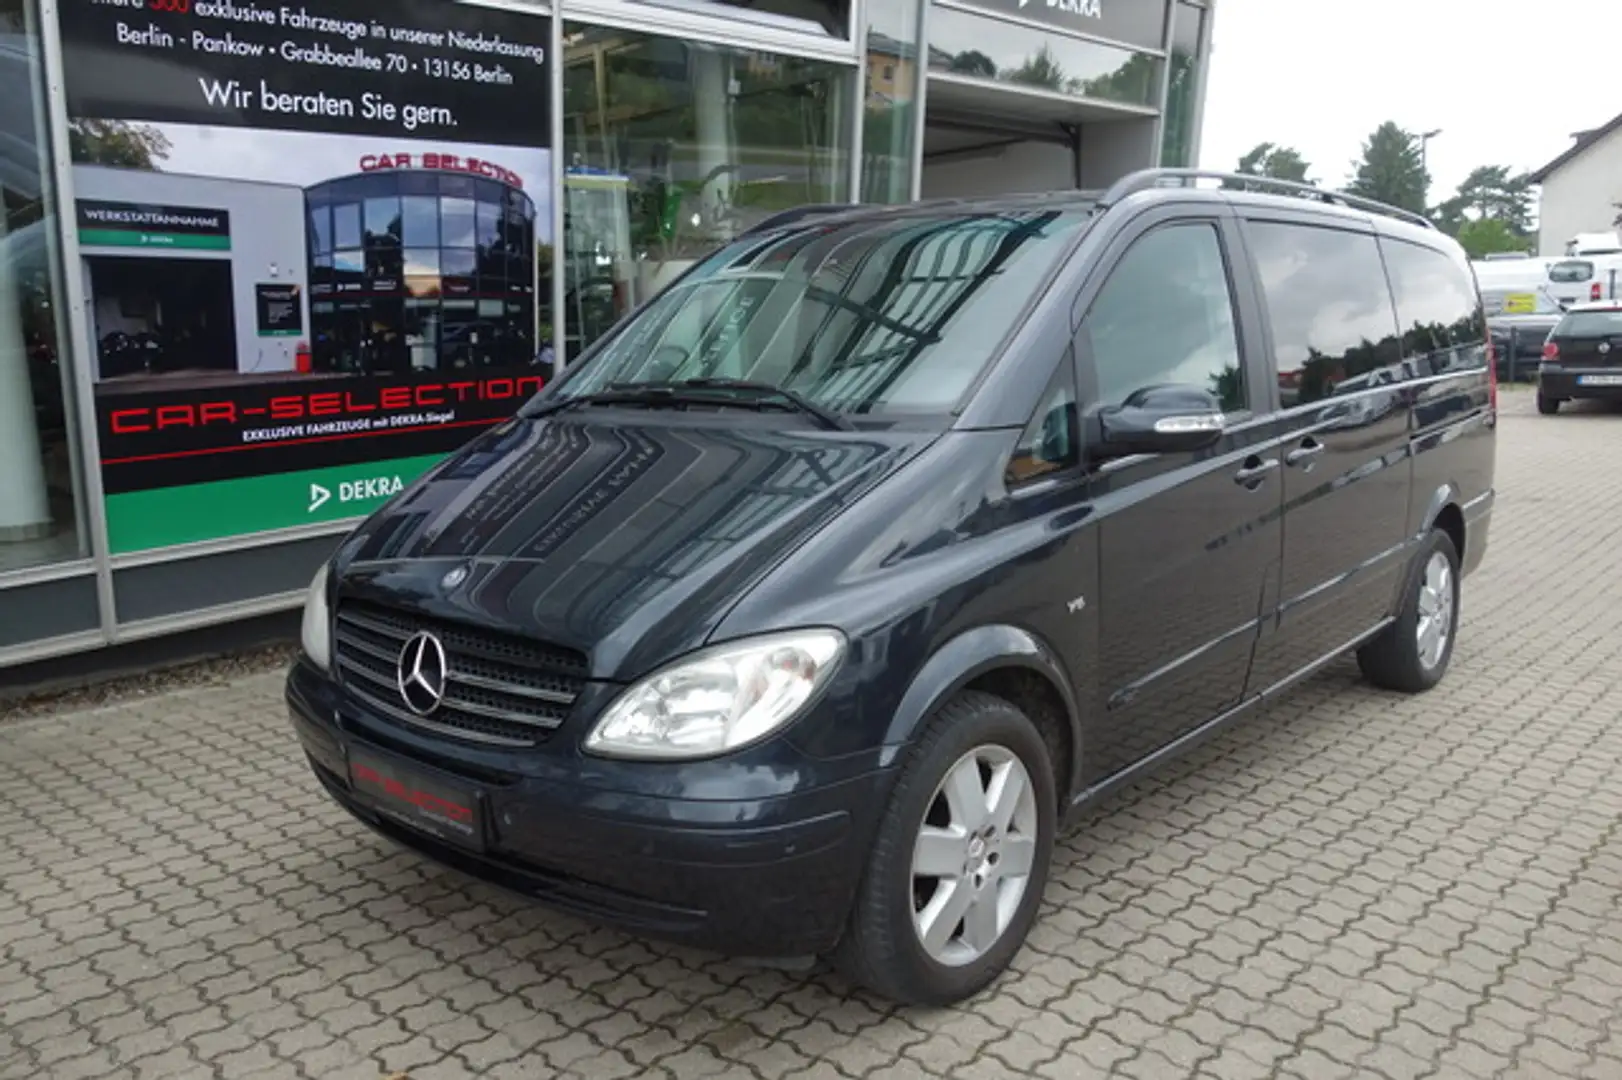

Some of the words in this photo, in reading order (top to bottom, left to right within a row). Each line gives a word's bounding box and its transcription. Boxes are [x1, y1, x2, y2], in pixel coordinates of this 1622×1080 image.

[116, 22, 173, 47] Berlin
[192, 30, 264, 57] Pankow
[280, 40, 382, 72] Grabbeallee
[385, 53, 408, 73] 70
[423, 57, 470, 81] 13156
[474, 63, 513, 85] Berlin
[195, 0, 275, 24] exklusive
[280, 7, 366, 39] Fahrzeuge
[371, 20, 386, 39] in
[390, 27, 445, 47] unserer
[448, 30, 544, 64] Niederlassung
[198, 77, 252, 109] Wir
[260, 79, 354, 118] beraten
[361, 92, 396, 121] Sie
[402, 103, 459, 130] gern.
[360, 153, 411, 173] CAR
[111, 376, 544, 433] CAR-SELECTION
[243, 424, 304, 442] EXKLUSIVE
[306, 418, 371, 434] FAHRZEUGE
[339, 475, 404, 502] DEKRA
